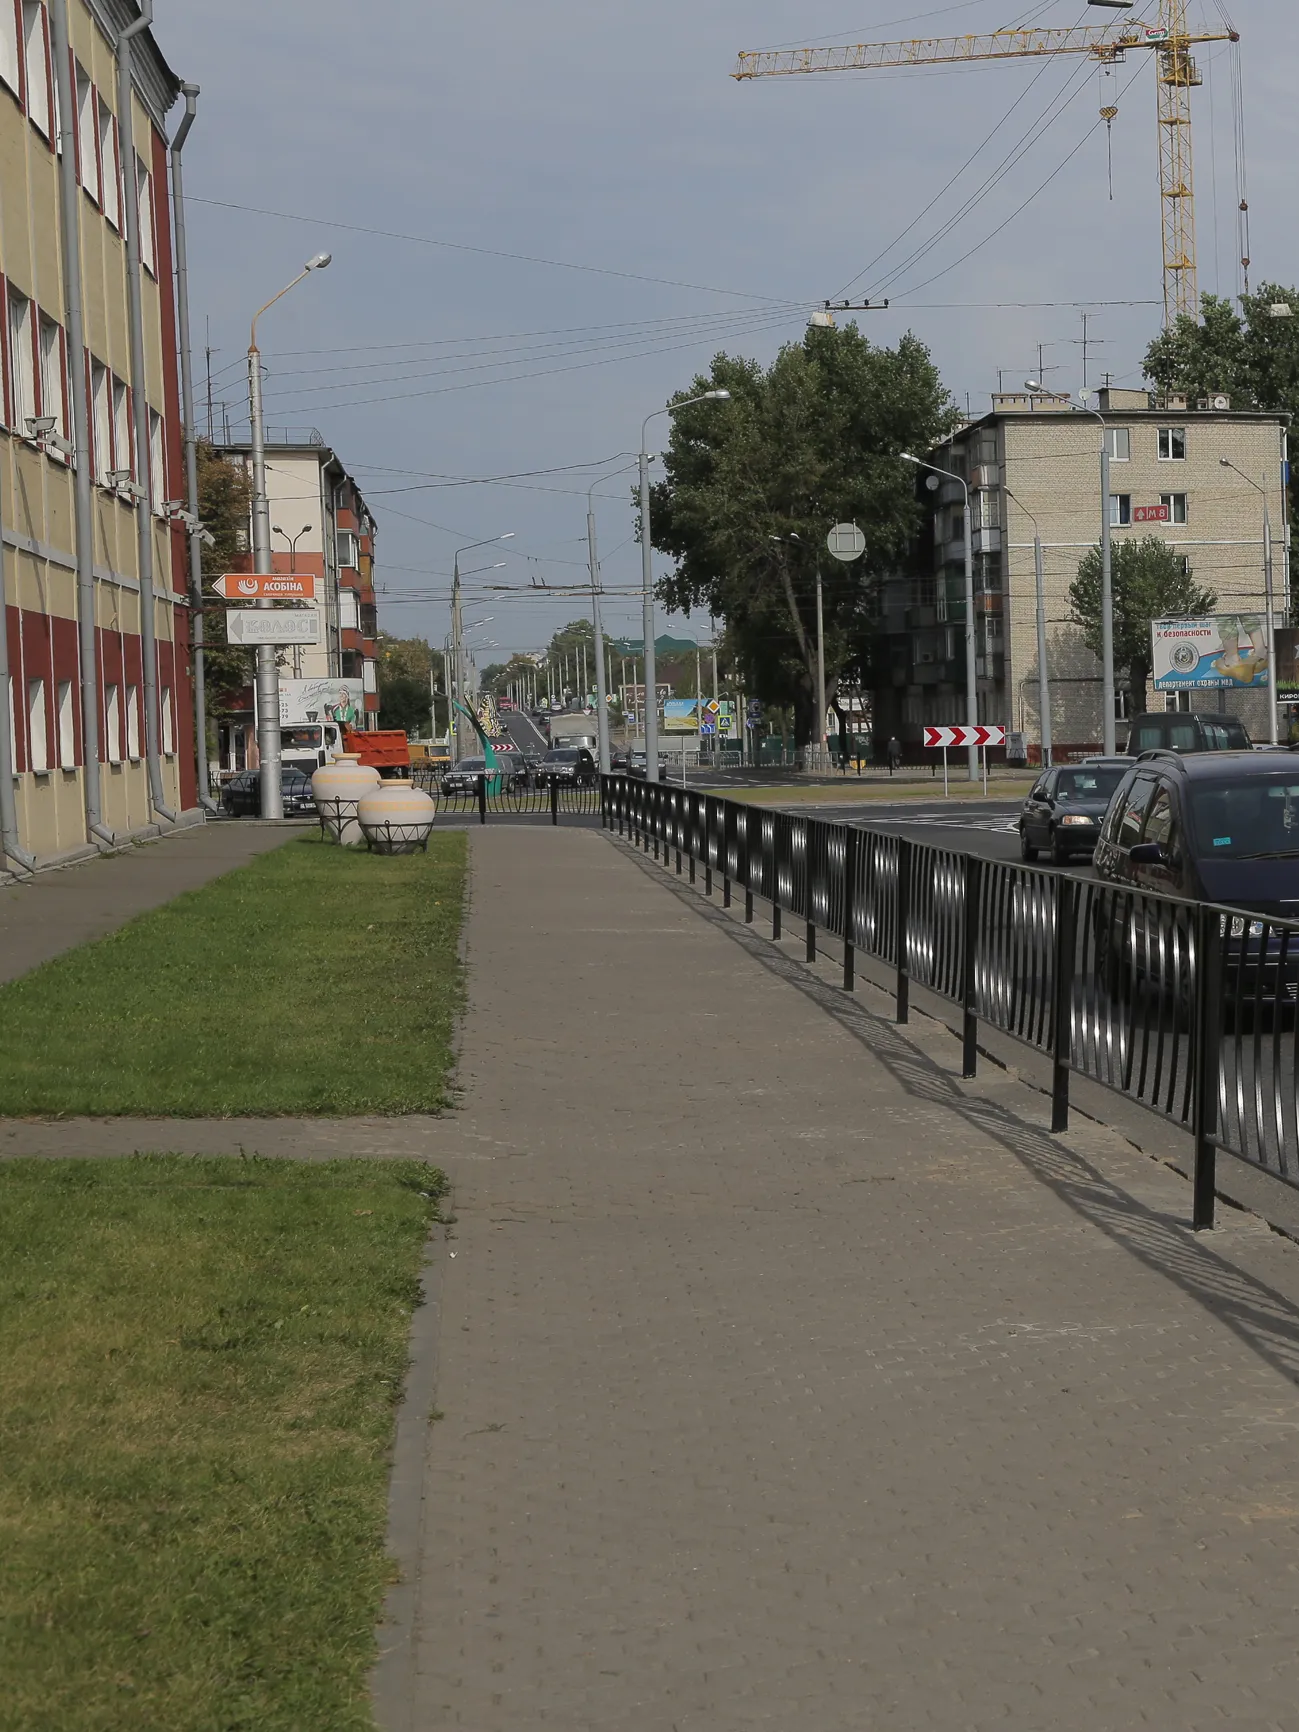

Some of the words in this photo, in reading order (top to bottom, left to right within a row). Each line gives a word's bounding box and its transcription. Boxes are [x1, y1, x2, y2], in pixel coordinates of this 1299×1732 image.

[1158, 508, 1165, 517] 8
[263, 582, 304, 591] АСОБІНА
[1163, 629, 1212, 638] безопасности
